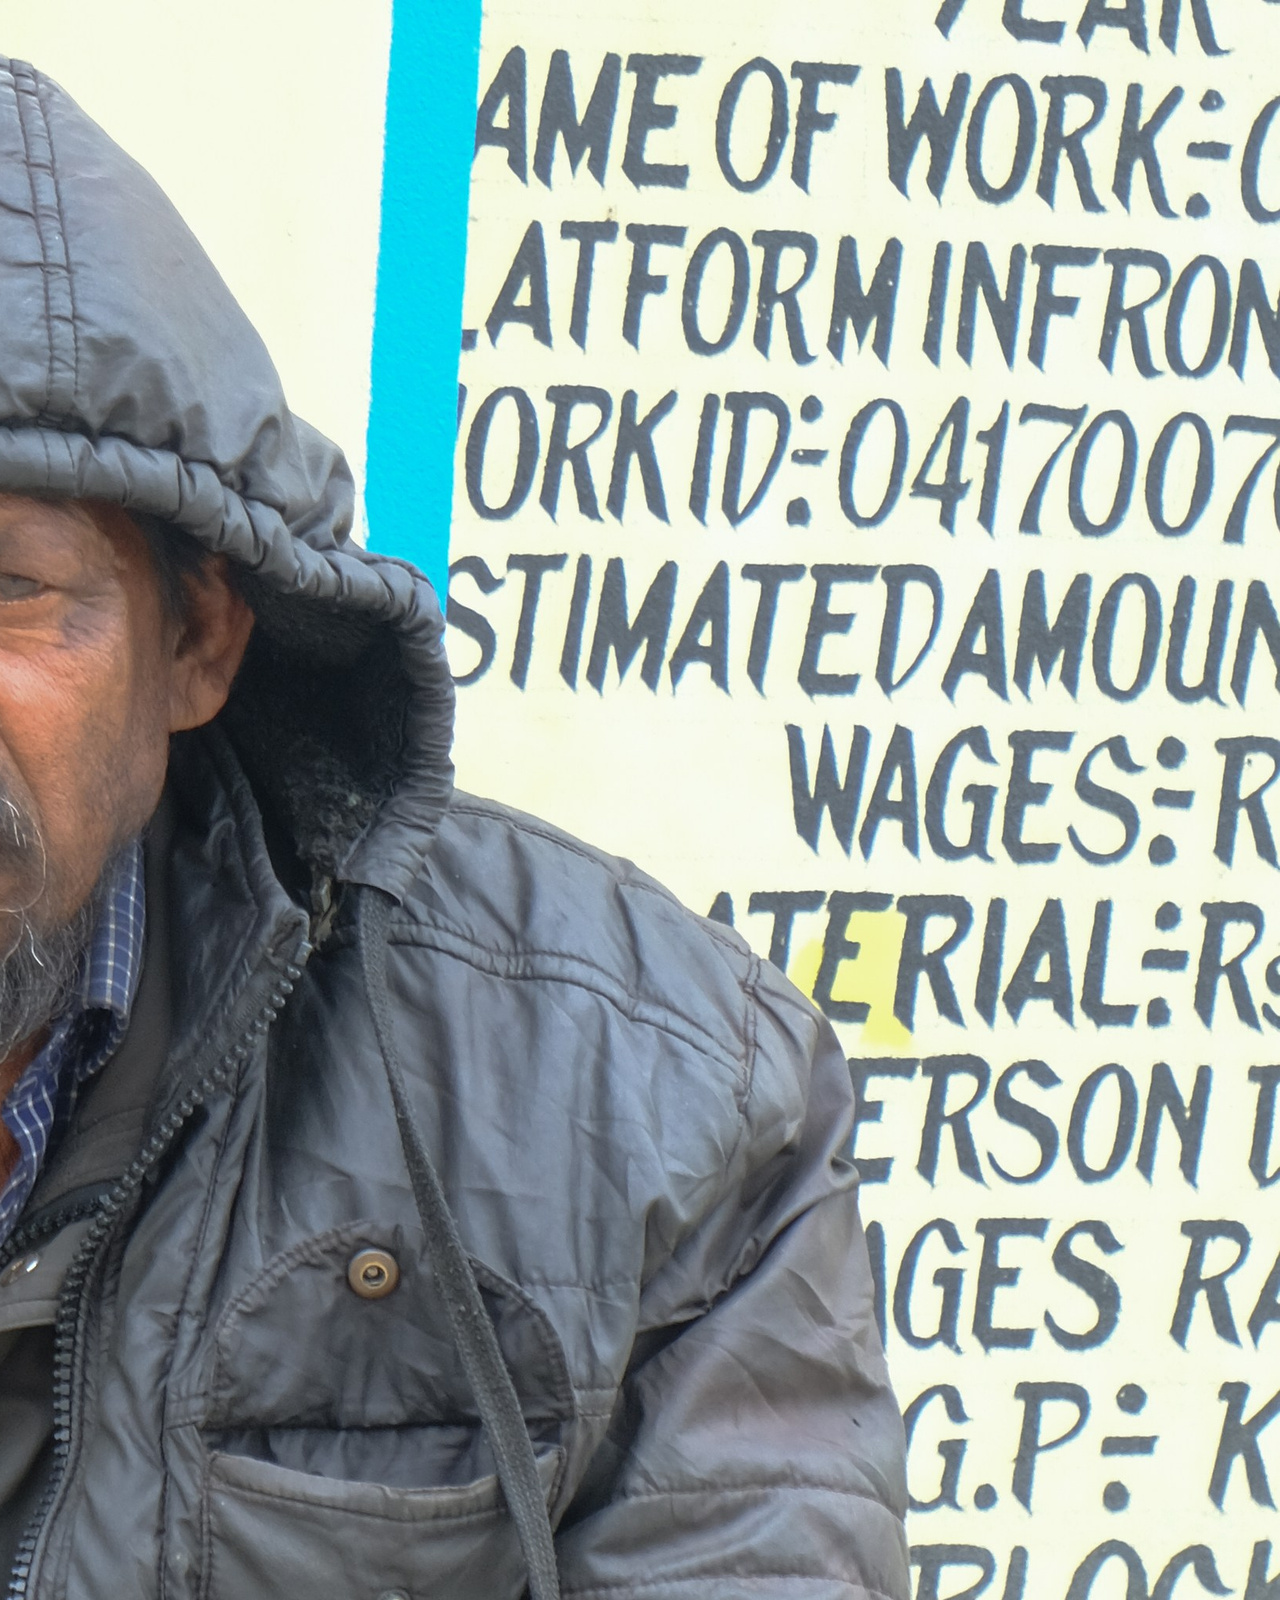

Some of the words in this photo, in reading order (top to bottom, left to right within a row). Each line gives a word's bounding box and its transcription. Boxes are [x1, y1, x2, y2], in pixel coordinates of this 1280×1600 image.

[715, 56, 862, 194] OF
[461, 218, 904, 370] ATFORM
[458, 384, 677, 524] ORK
